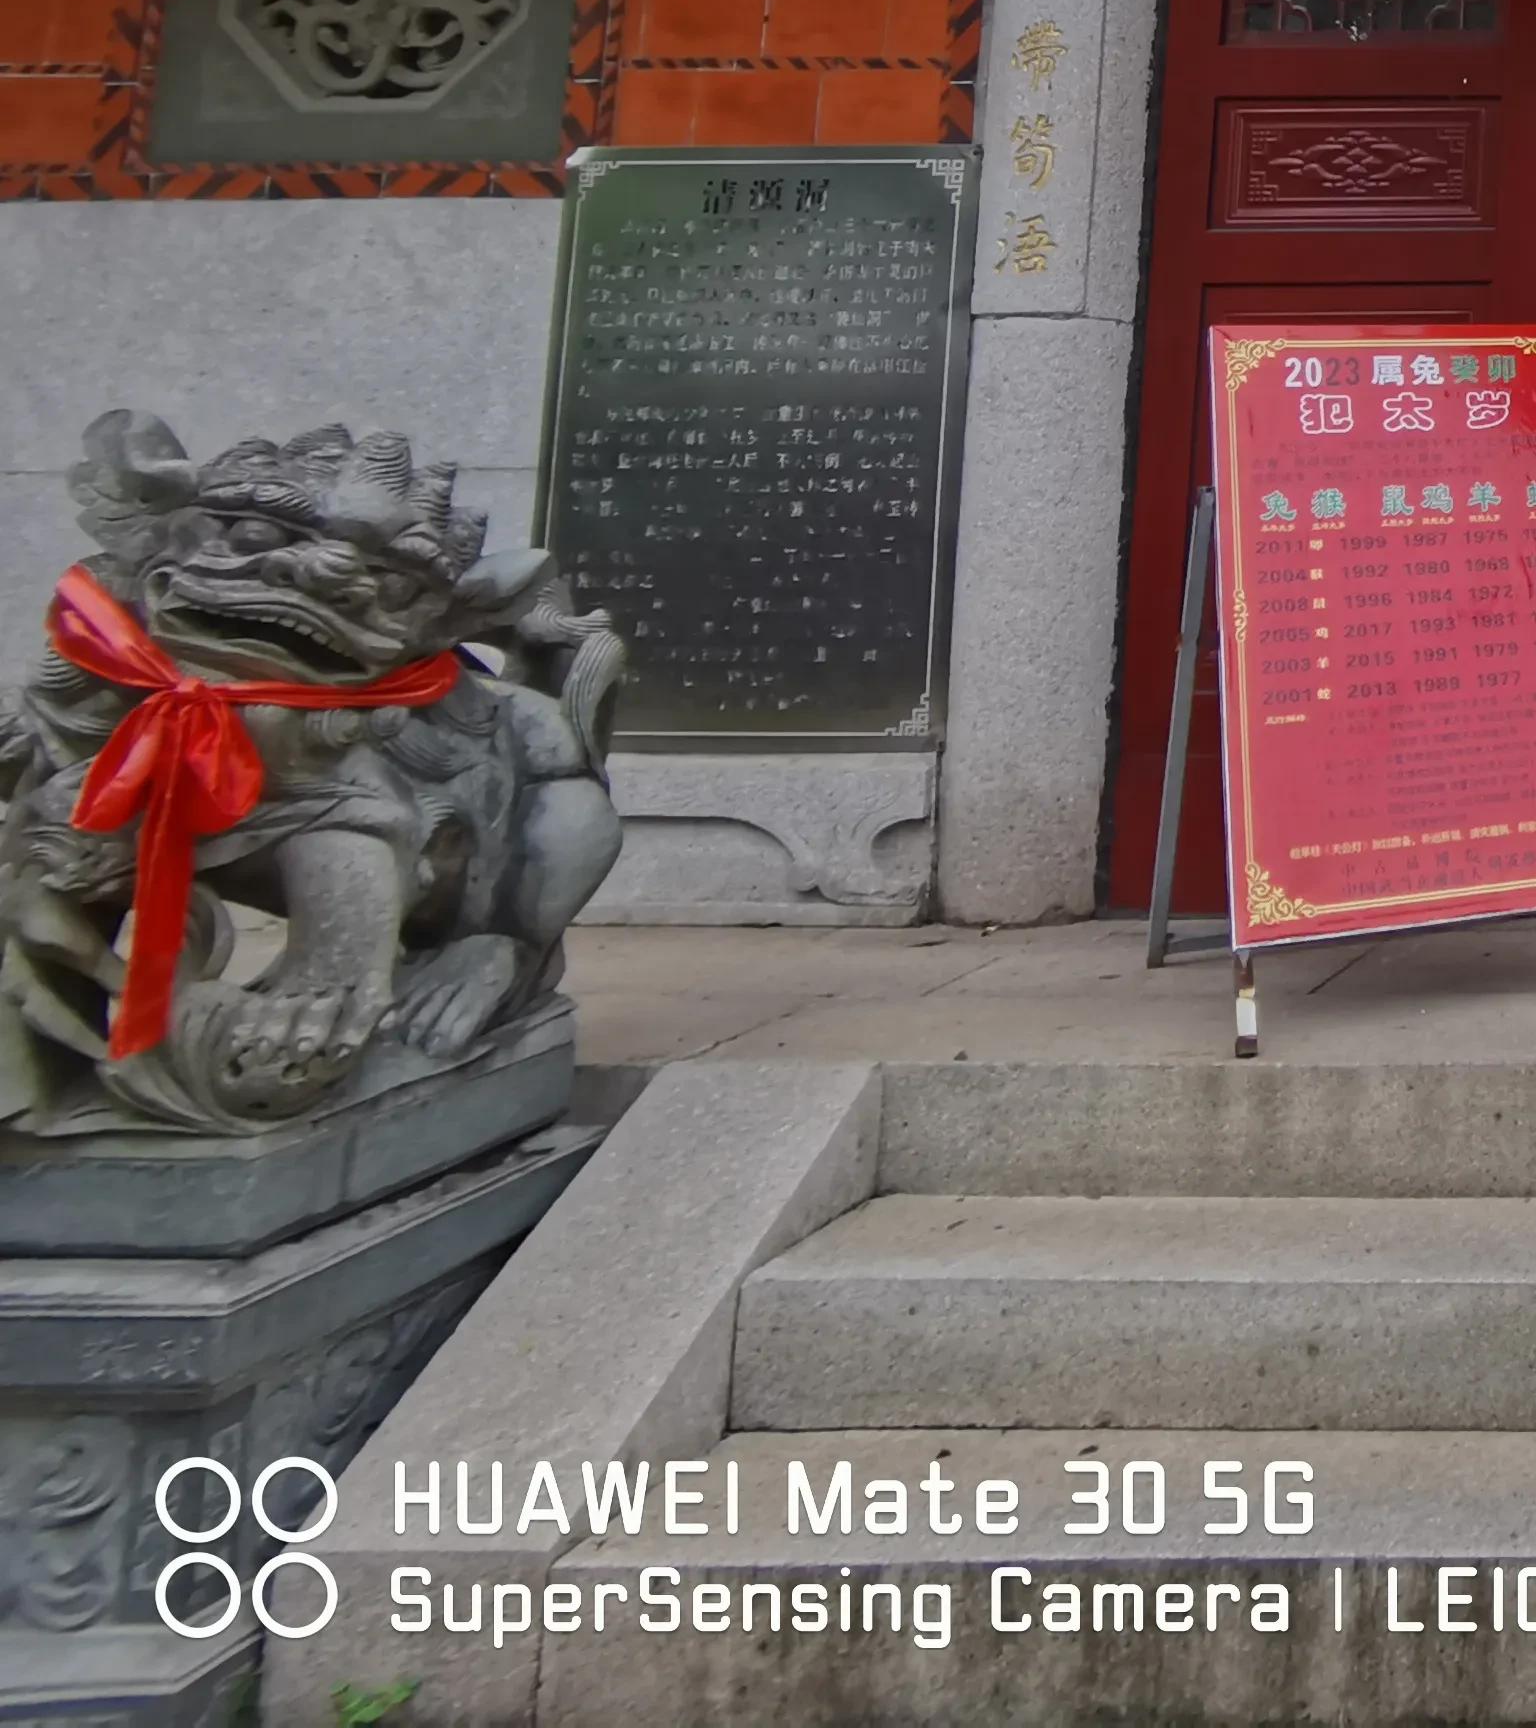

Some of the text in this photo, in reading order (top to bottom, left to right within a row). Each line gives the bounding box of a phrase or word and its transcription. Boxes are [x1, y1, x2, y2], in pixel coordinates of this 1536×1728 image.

[1285, 356, 1360, 388] 2023
[1300, 391, 1511, 435] 犯太岁
[1260, 489, 1297, 522] 兔
[1311, 487, 1347, 518] 猴
[1381, 483, 1414, 516] 鼠
[1422, 481, 1454, 513] 鸡
[1468, 480, 1501, 512] 羊
[1340, 535, 1388, 551] 1999
[1403, 532, 1448, 547] 1987
[1404, 560, 1450, 576] 1980
[1344, 593, 1393, 610] 1996
[1406, 589, 1453, 605] 1984
[1468, 585, 1514, 601] 1972
[1343, 623, 1393, 639] 2017
[1410, 617, 1457, 634] 1993
[1346, 651, 1396, 668] 2015
[1413, 647, 1458, 663] 1991
[1474, 641, 1519, 658] 1979
[1347, 682, 1397, 699] 2013
[1414, 677, 1460, 693] 1989
[1477, 670, 1522, 688] 1977
